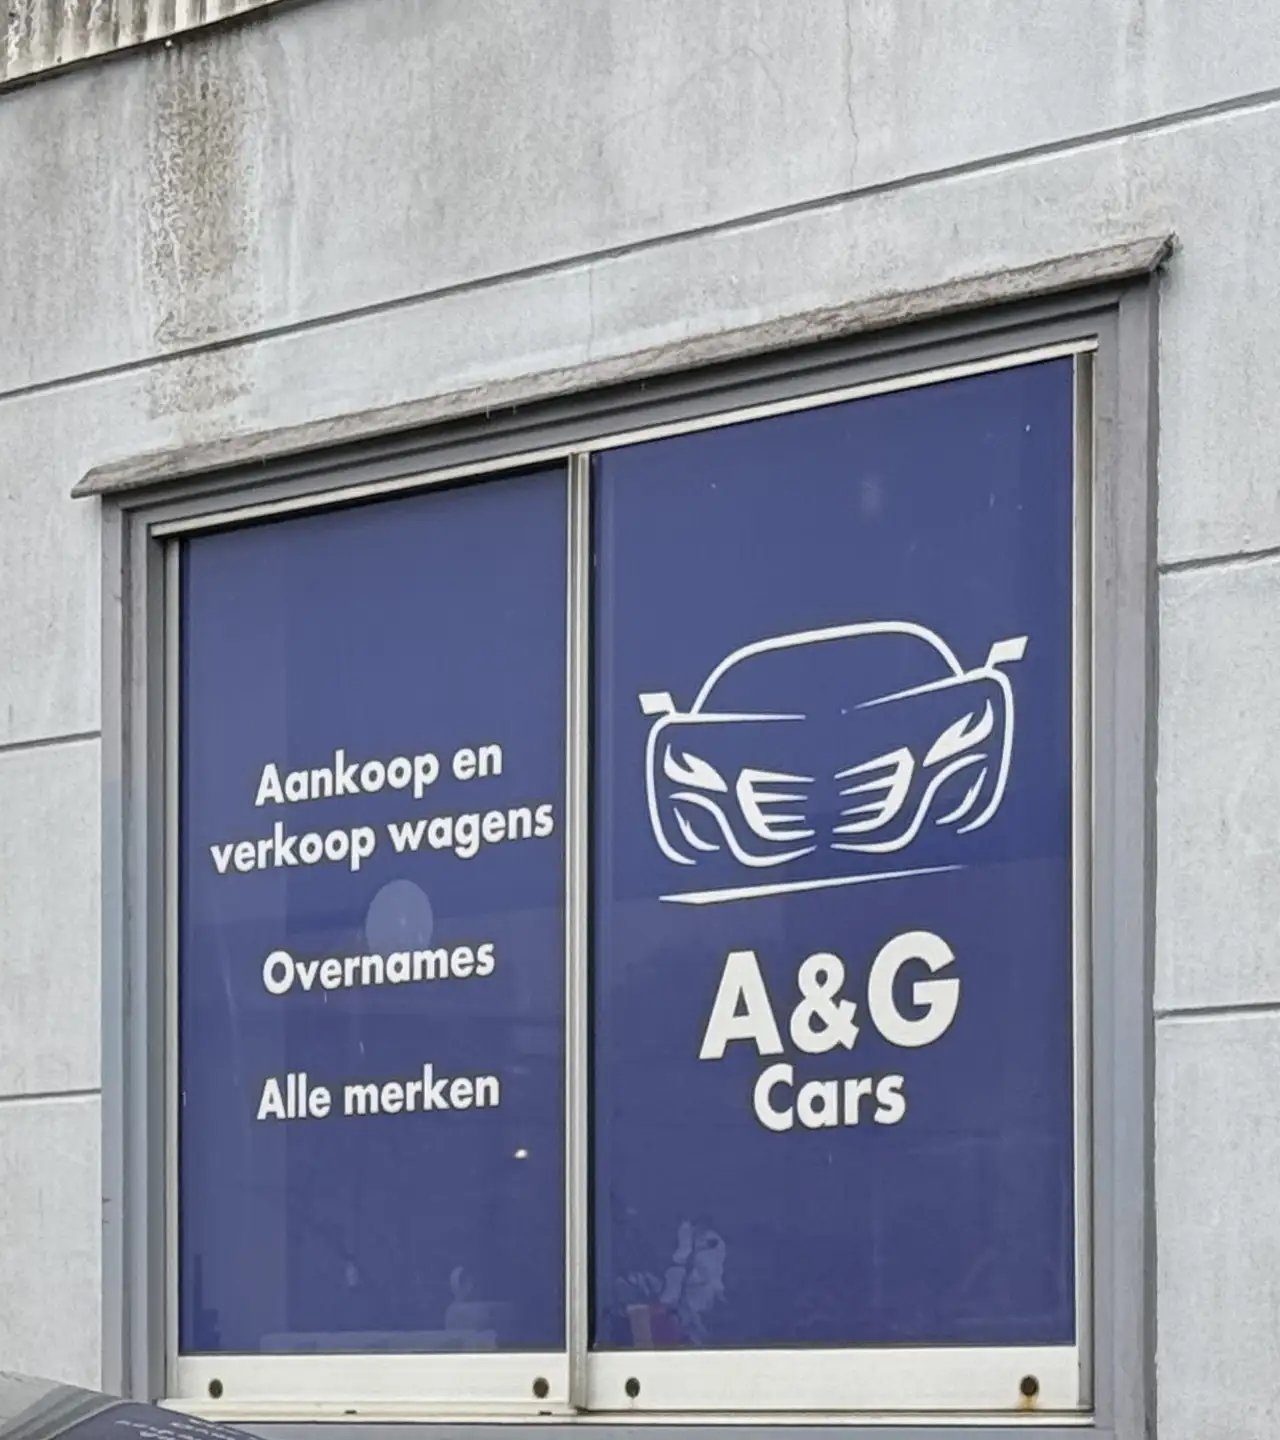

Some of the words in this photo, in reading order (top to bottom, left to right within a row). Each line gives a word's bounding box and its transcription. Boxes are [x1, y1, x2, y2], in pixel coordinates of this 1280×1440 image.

[253, 748, 441, 807] Aankoop
[452, 744, 503, 782] en
[209, 820, 377, 873] verkoop
[386, 803, 555, 859] wagens
[261, 942, 496, 995] Overnames
[698, 929, 961, 1061] A&G
[255, 1071, 332, 1121] Alle
[343, 1062, 501, 1116] merken
[752, 1062, 907, 1132] Cars
